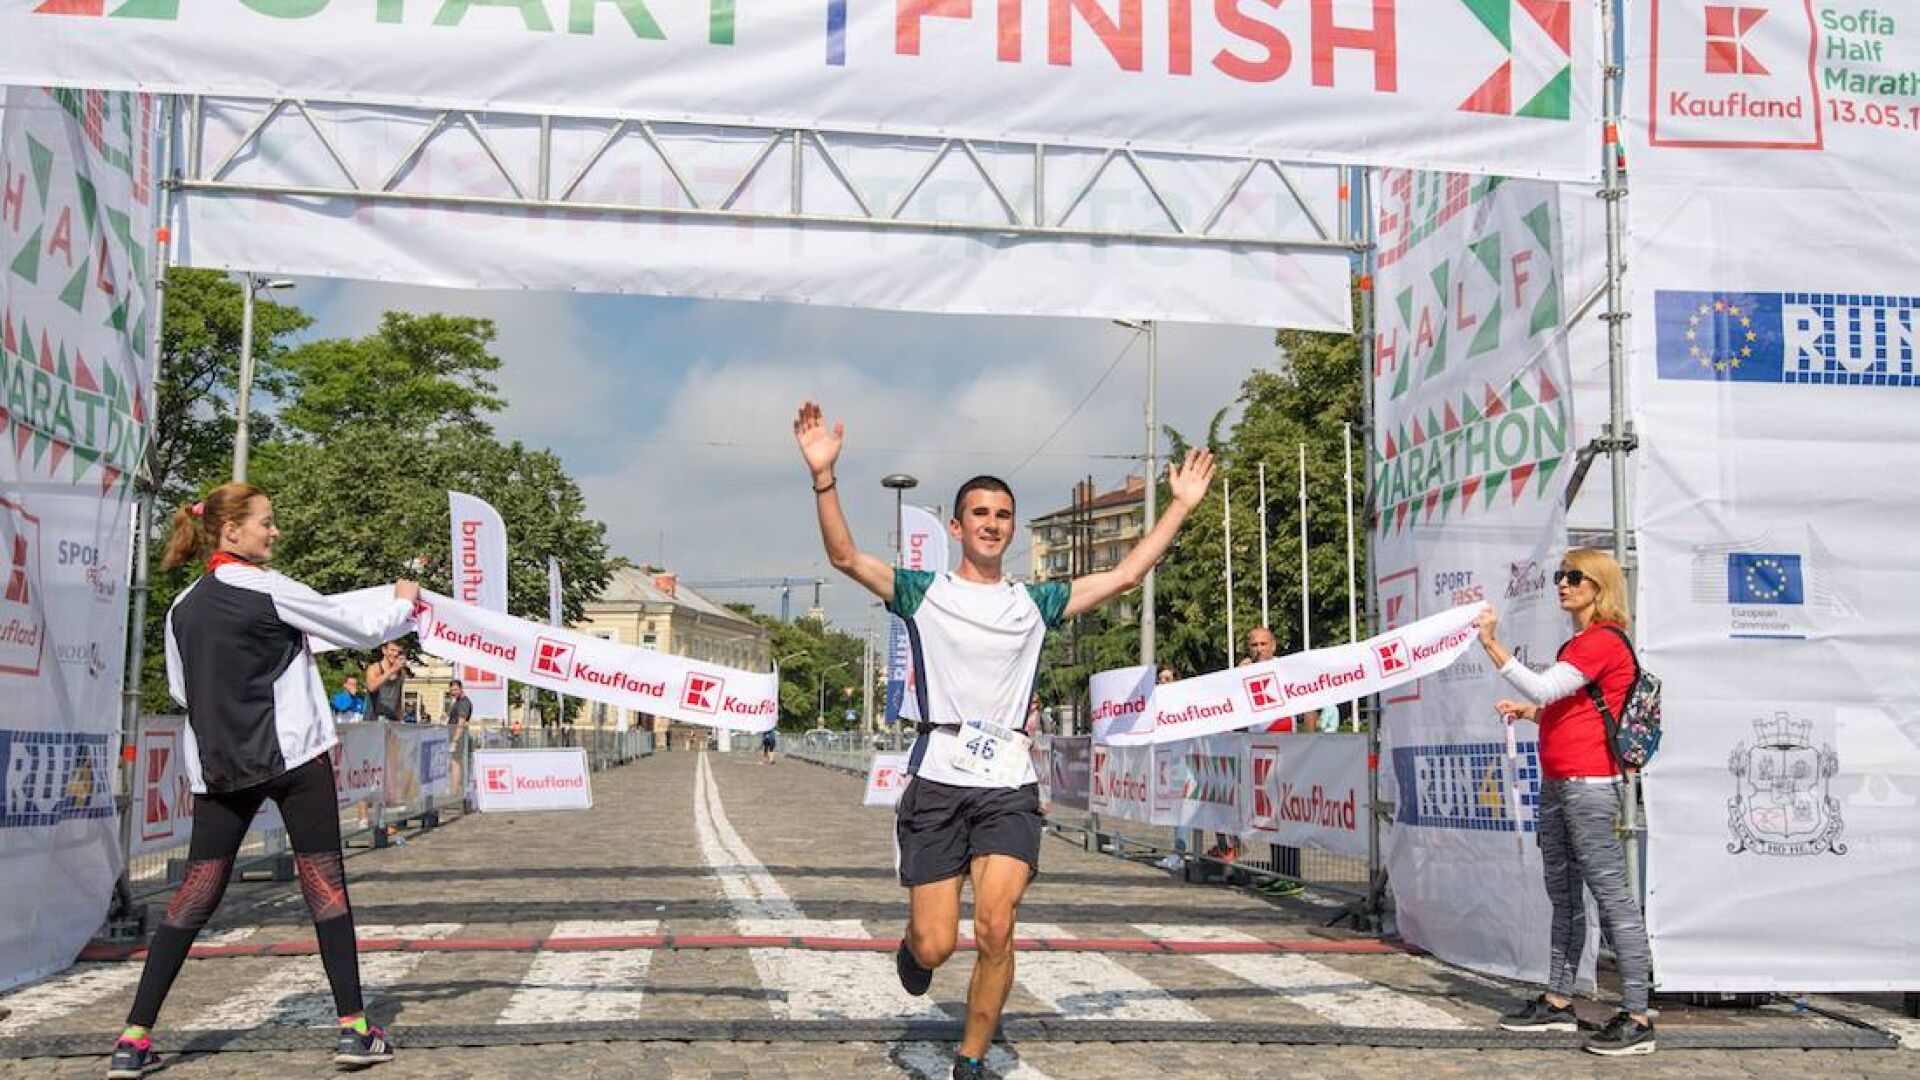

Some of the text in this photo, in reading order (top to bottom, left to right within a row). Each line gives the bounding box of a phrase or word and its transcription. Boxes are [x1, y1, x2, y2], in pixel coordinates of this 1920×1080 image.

[1820, 9, 1895, 36] Sofia
[895, 0, 1397, 92] FINISH
[1826, 36, 1883, 62] Half
[1669, 91, 1802, 119] Kaufland
[1376, 250, 1533, 377] HALF
[1375, 400, 1567, 508] MARATHON
[1435, 571, 1473, 597] SPORT
[434, 621, 517, 661] Kaufland
[575, 662, 665, 698] Kaufland
[1156, 698, 1233, 726] Kaufland
[1284, 664, 1365, 699] Kaufland
[965, 735, 994, 760] 46
[516, 775, 584, 790] Kaufland
[1280, 783, 1355, 830] Kaufland
